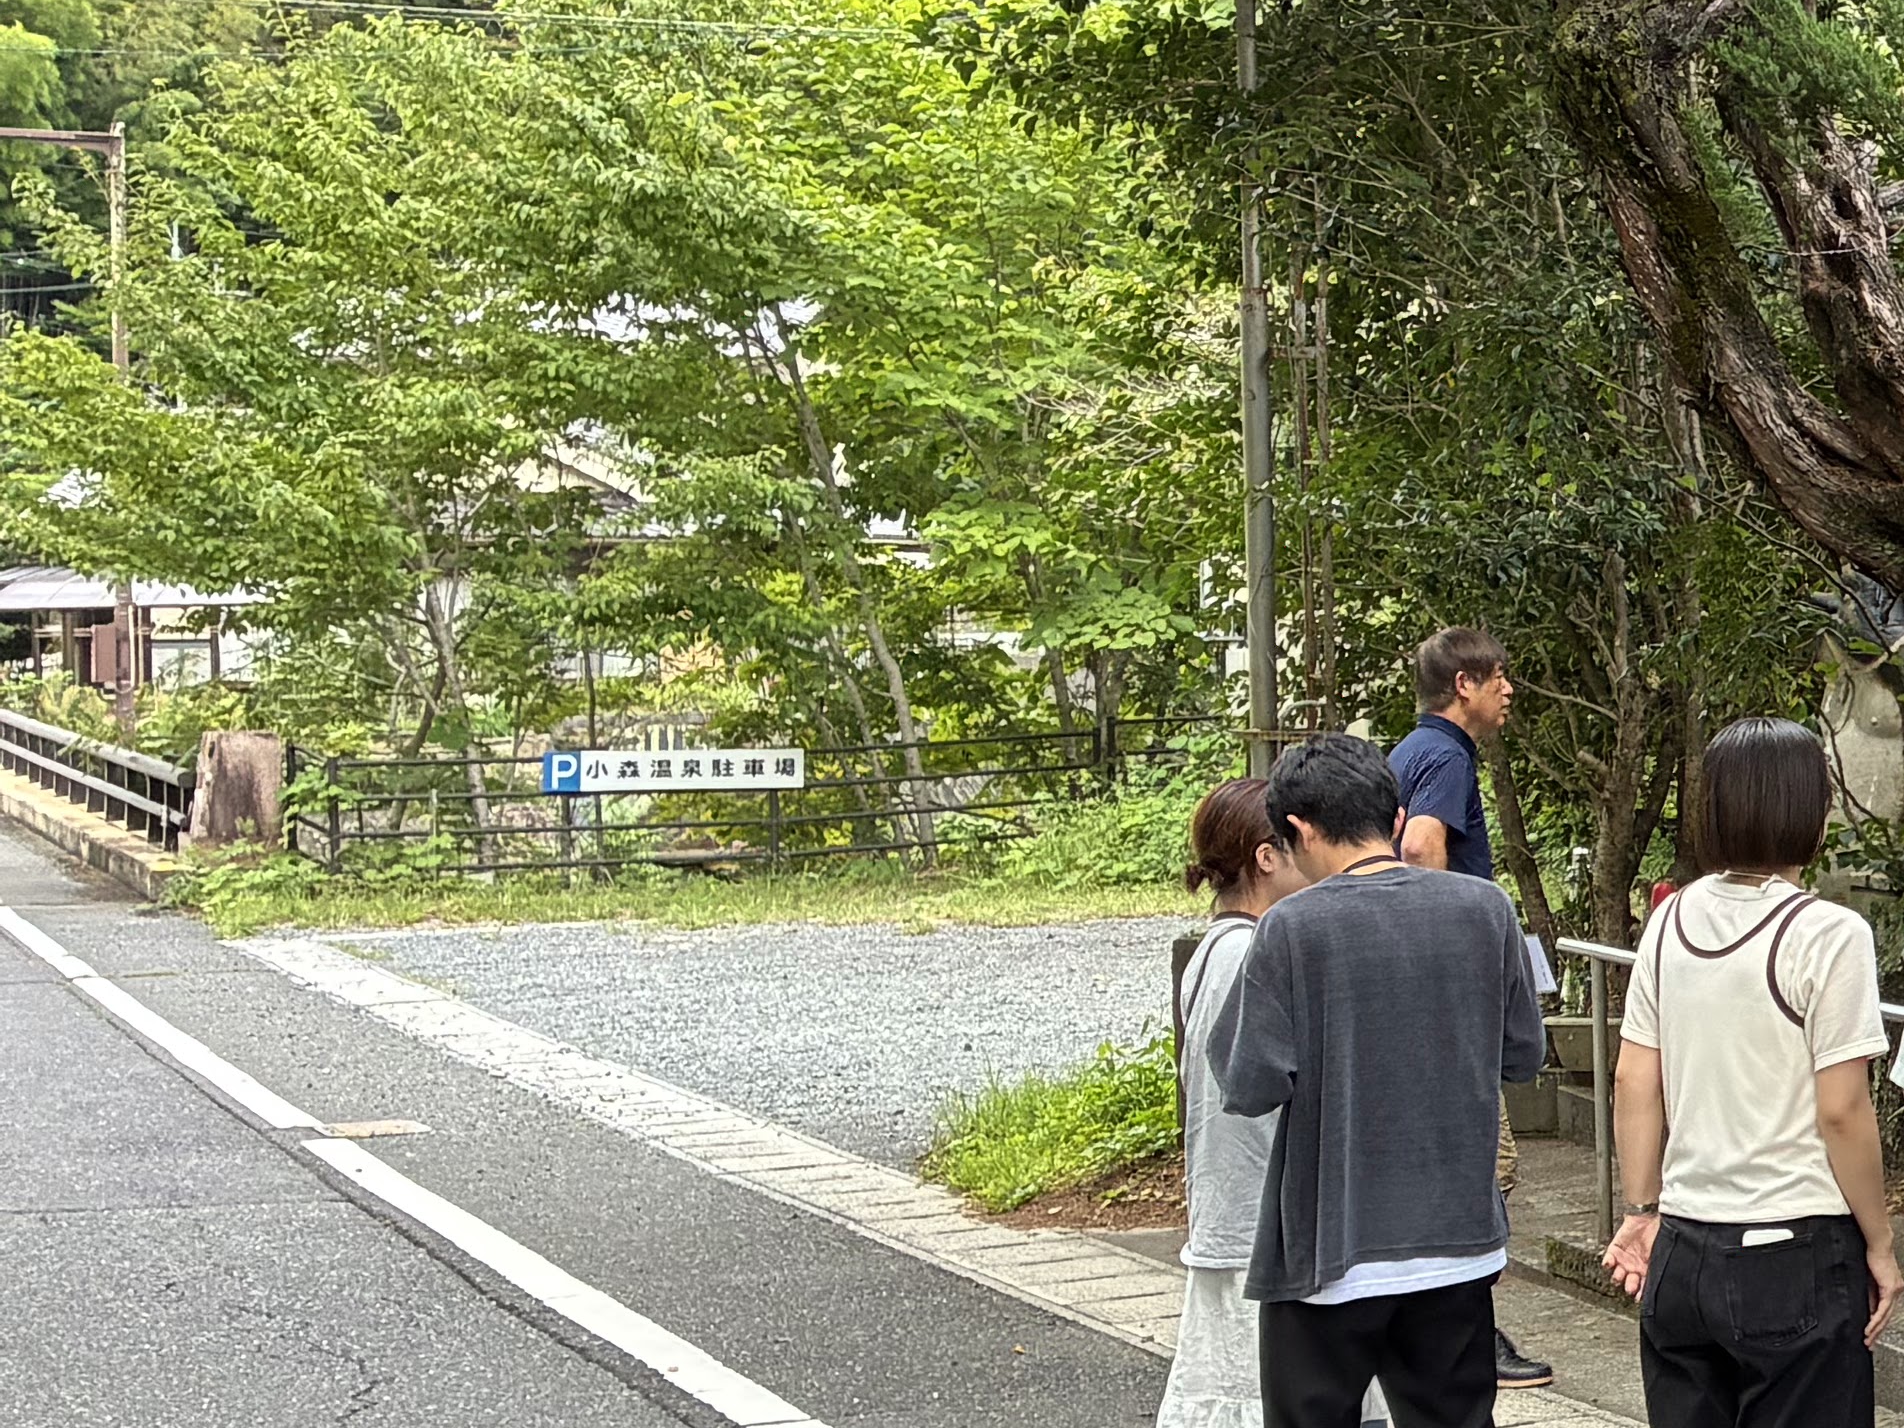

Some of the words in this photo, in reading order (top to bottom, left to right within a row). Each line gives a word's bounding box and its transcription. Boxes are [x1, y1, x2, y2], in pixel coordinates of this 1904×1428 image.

[552, 754, 578, 790] P
[585, 756, 797, 780] 小森温泉駐車場
